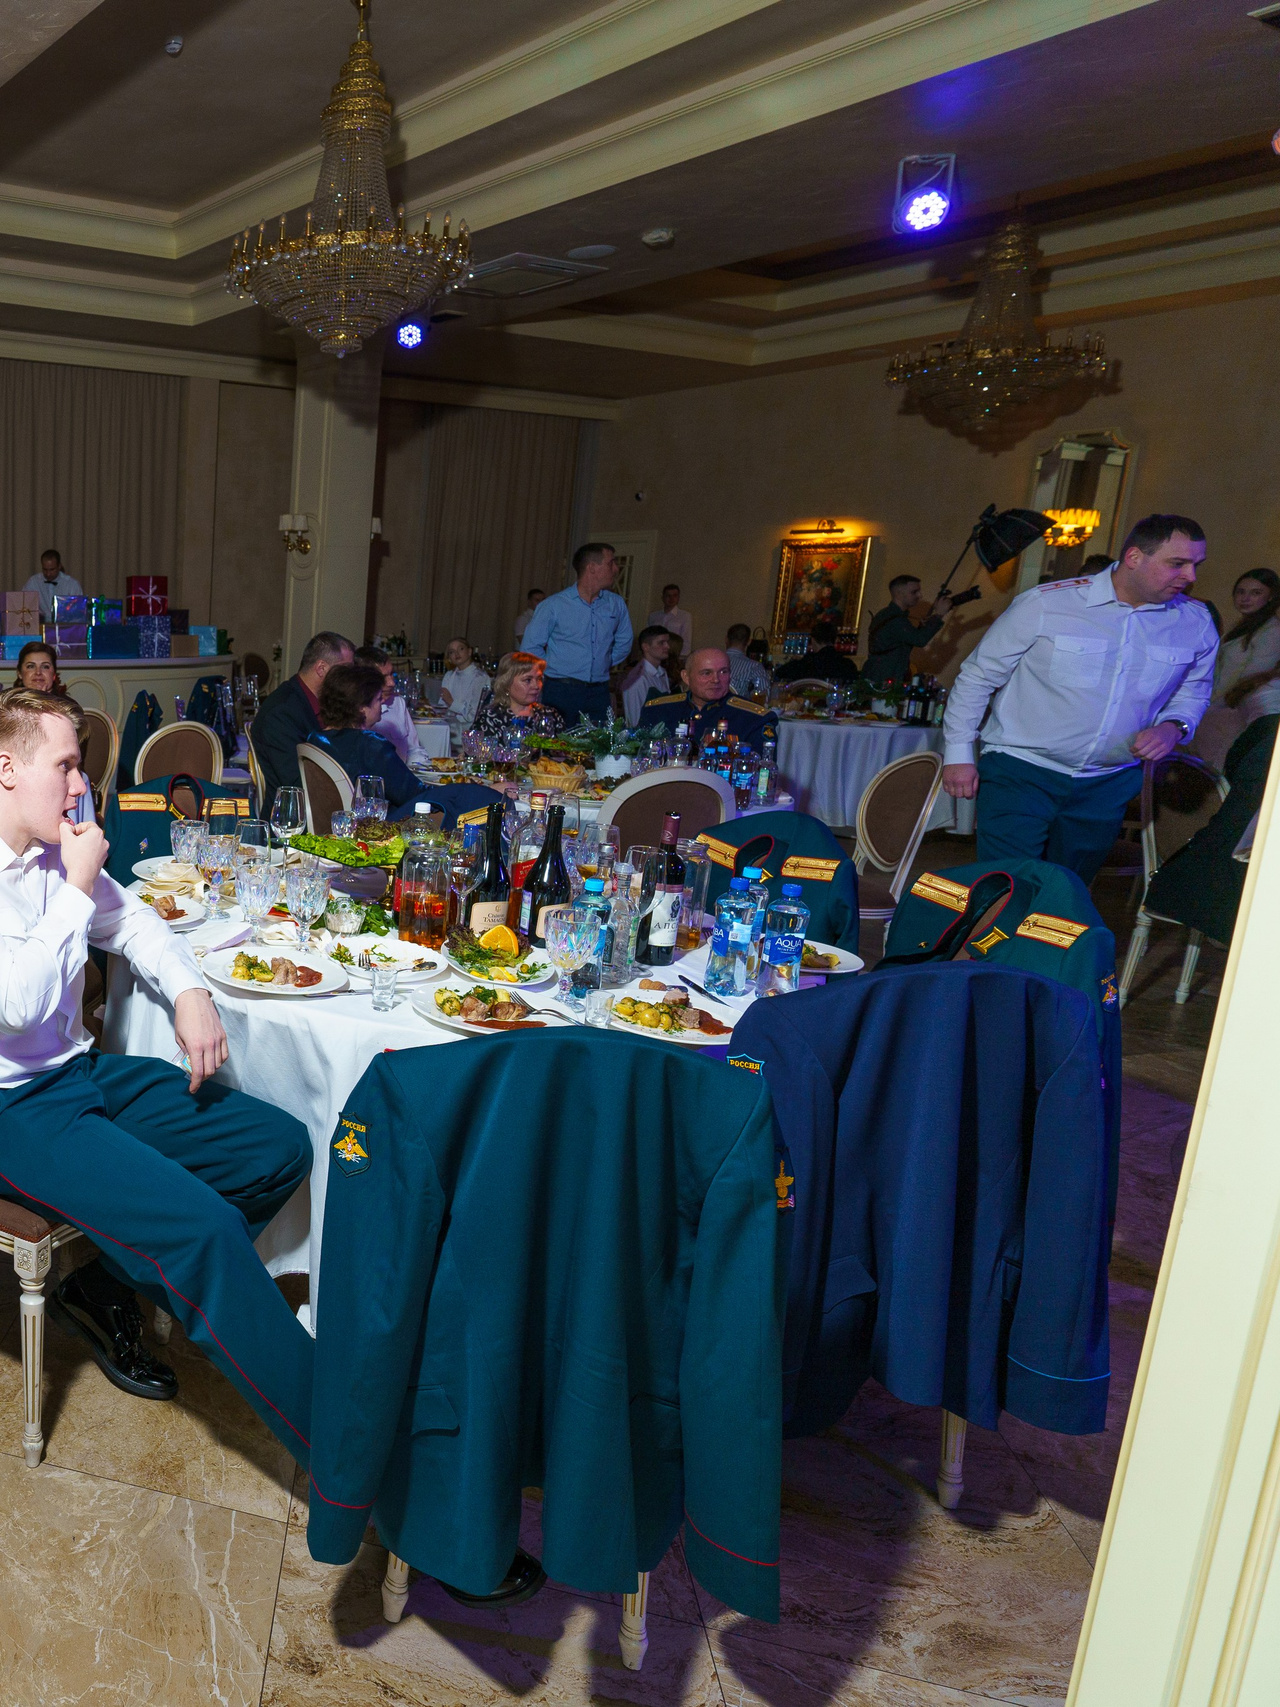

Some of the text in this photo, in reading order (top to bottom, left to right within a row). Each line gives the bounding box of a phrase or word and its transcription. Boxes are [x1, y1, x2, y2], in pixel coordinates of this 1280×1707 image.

[775, 937, 802, 948] AQUA
[730, 1060, 760, 1070] РОССИЯ
[341, 1119, 366, 1132] РОССИЯ
